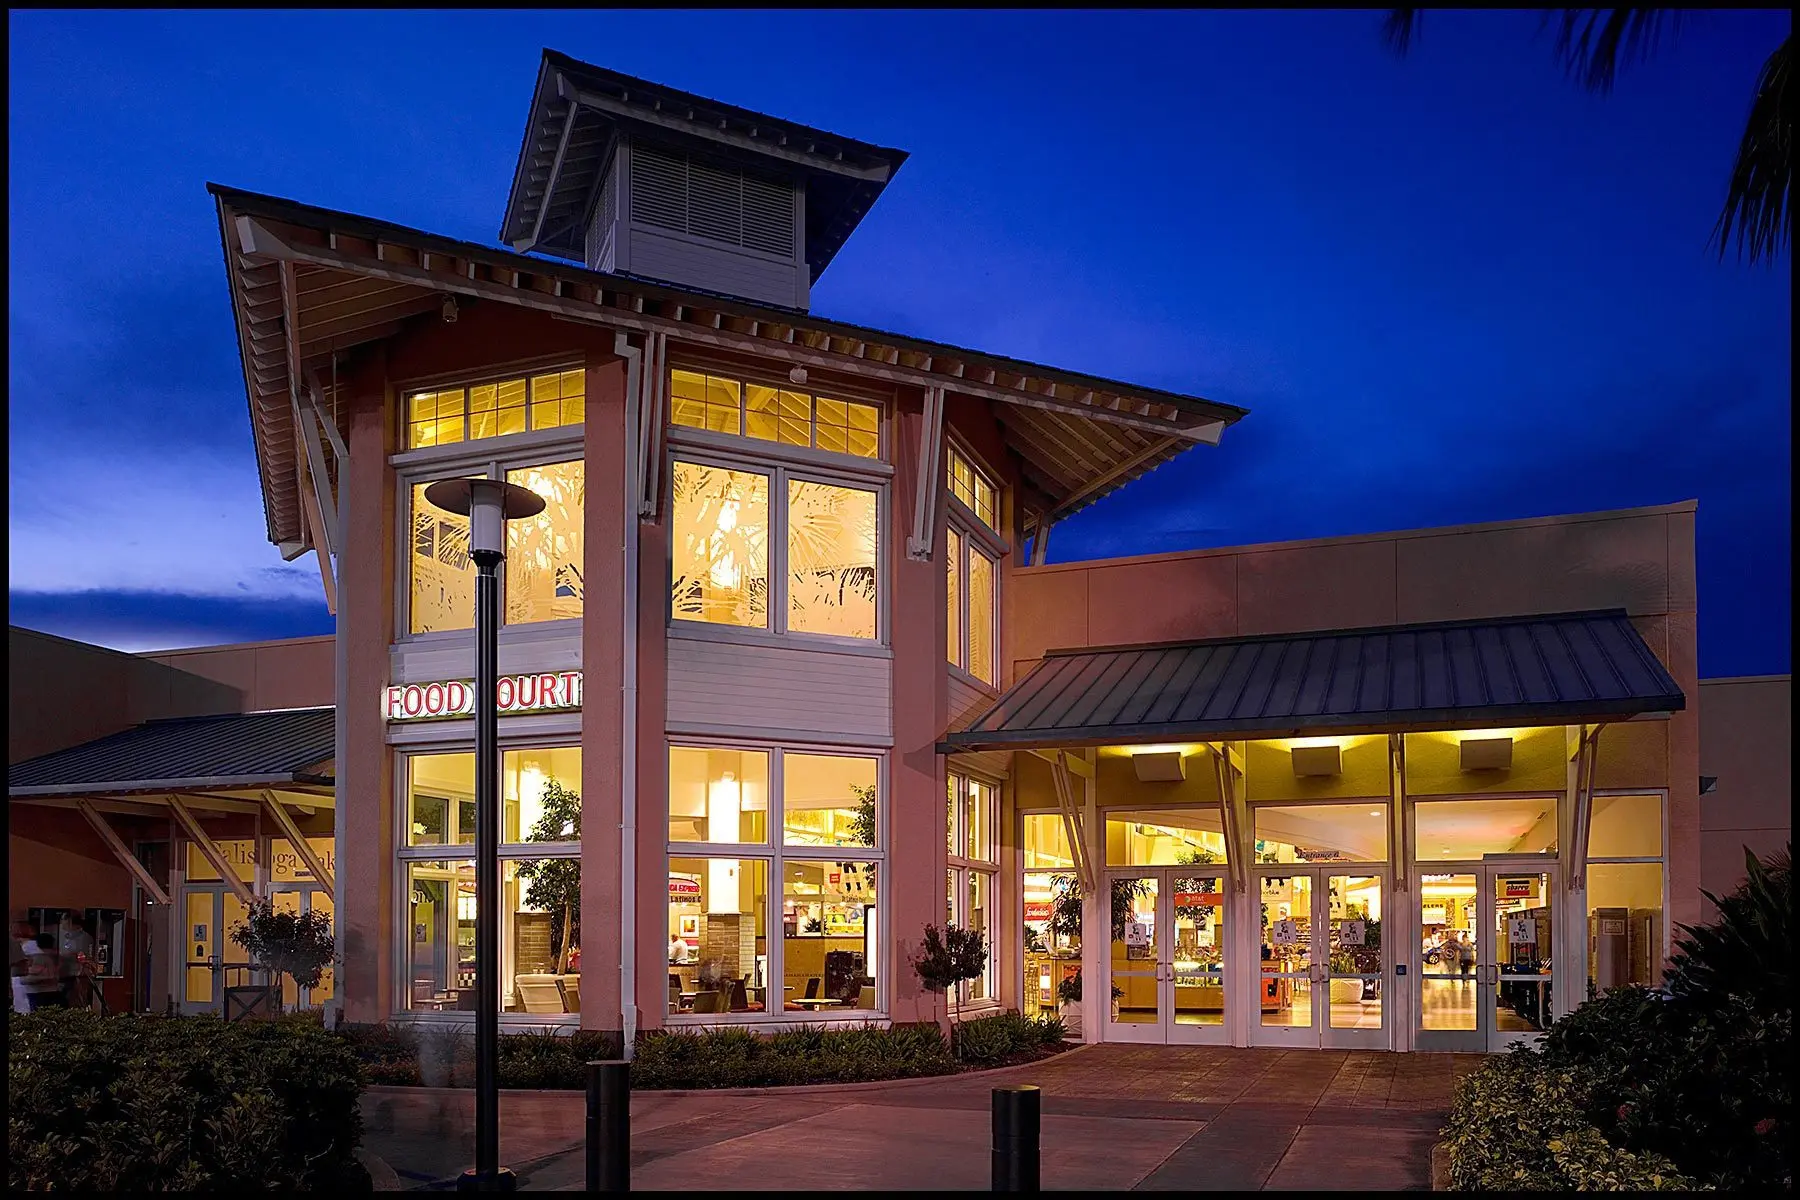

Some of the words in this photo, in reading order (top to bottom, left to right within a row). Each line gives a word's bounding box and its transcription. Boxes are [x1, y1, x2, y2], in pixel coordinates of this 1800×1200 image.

[387, 681, 466, 718] FOOD
[496, 671, 579, 710] OURT
[670, 895, 695, 903] Latinos
